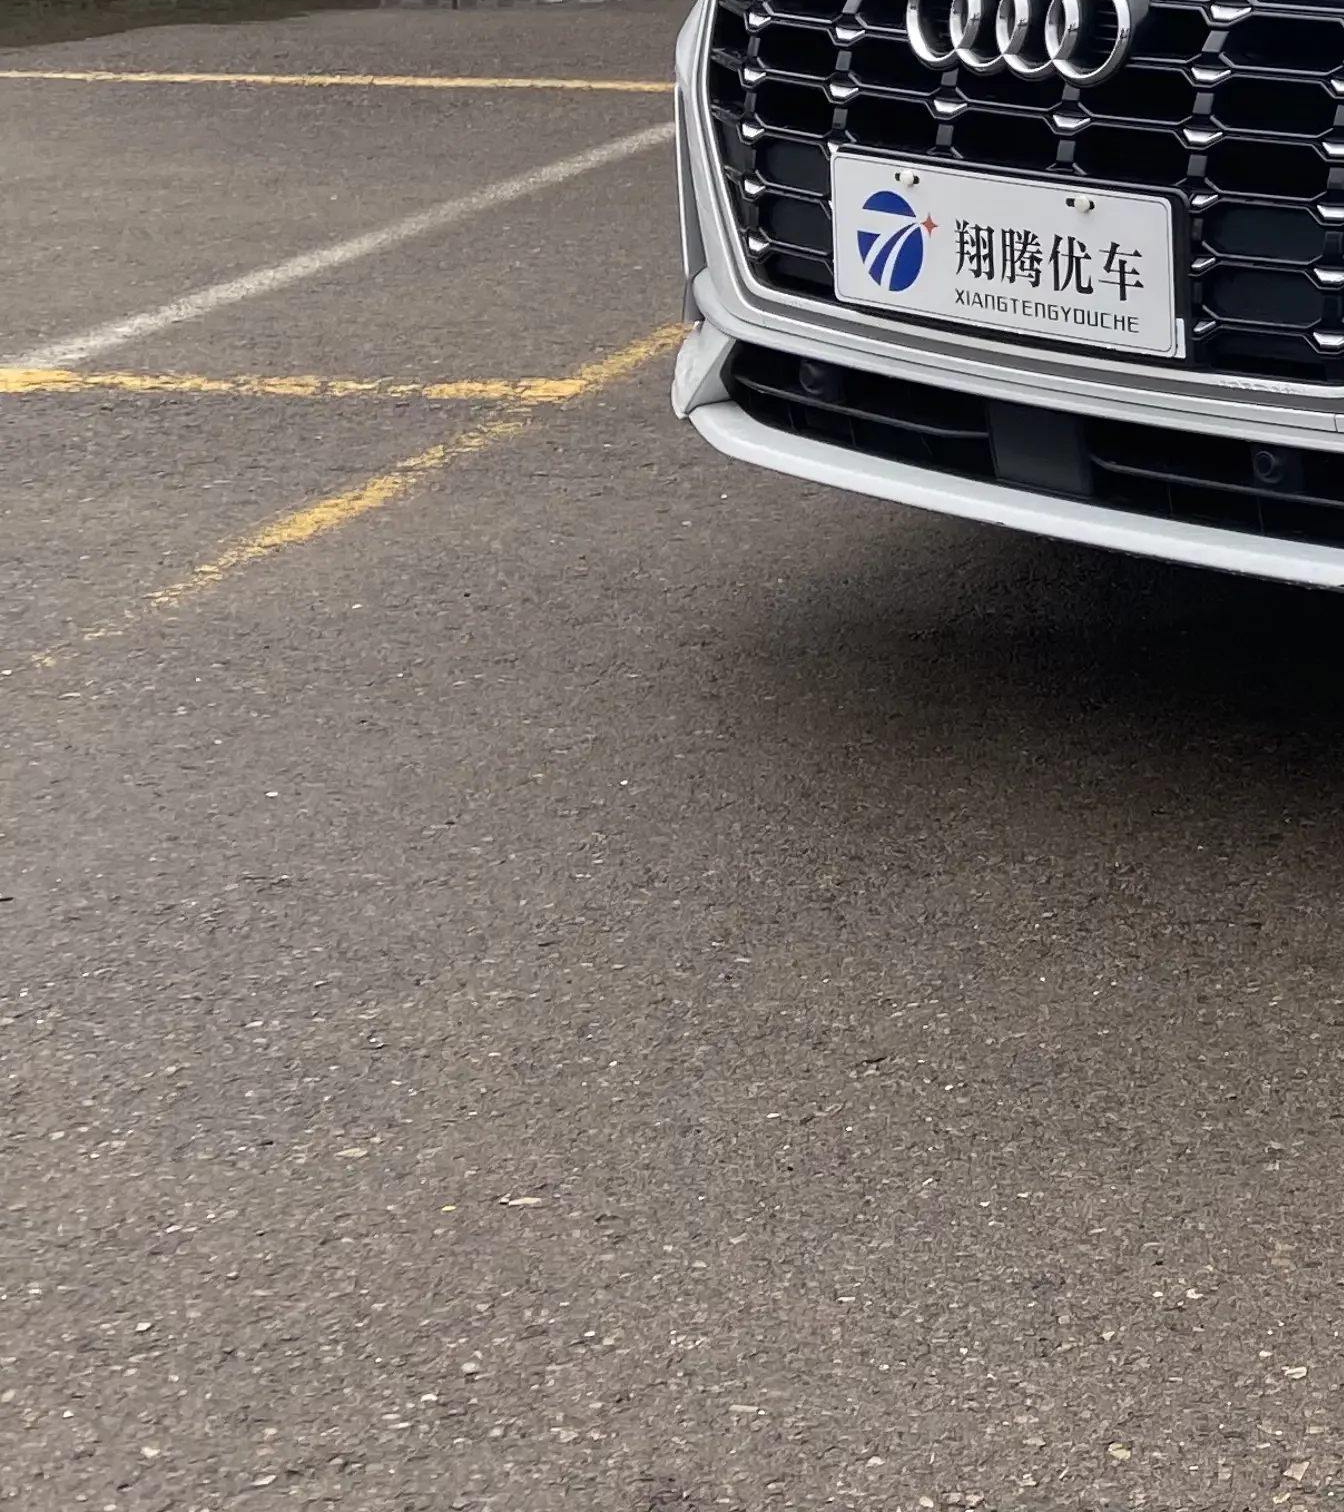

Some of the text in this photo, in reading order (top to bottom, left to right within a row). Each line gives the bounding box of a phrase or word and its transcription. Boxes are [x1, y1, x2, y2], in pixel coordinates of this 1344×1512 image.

[953, 219, 1144, 302] 翔腾优车
[953, 288, 1140, 335] XIANGTENGYOUCHE
